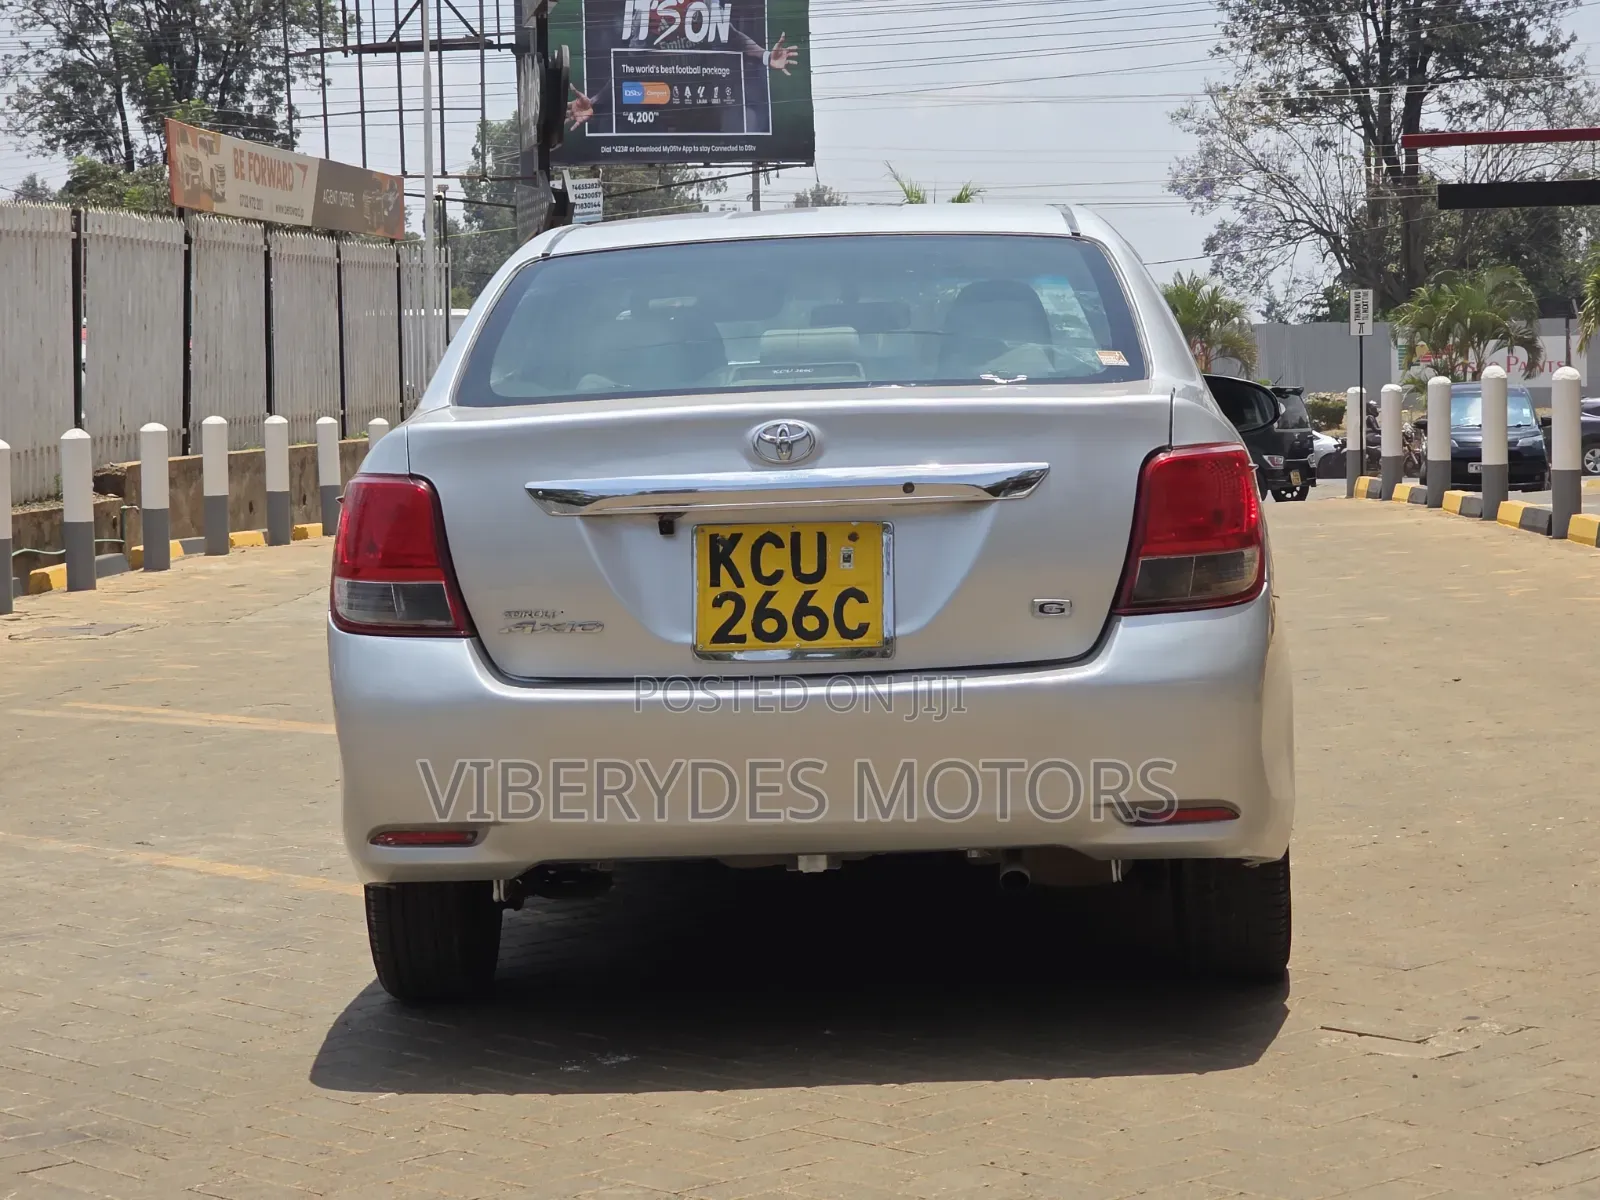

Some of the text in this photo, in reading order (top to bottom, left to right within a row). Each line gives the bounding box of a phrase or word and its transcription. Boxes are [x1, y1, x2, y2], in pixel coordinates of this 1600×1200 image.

[622, 0, 732, 45] IT'S ON
[622, 64, 730, 77] The world's best football package
[627, 111, 654, 124] 4,200
[682, 146, 693, 154] App
[699, 146, 710, 154] stay
[233, 147, 295, 192] BE FORWARD
[709, 531, 827, 588] KCU
[709, 587, 870, 644] 266C
[1038, 602, 1066, 615] G
[499, 620, 604, 634] AXIO
